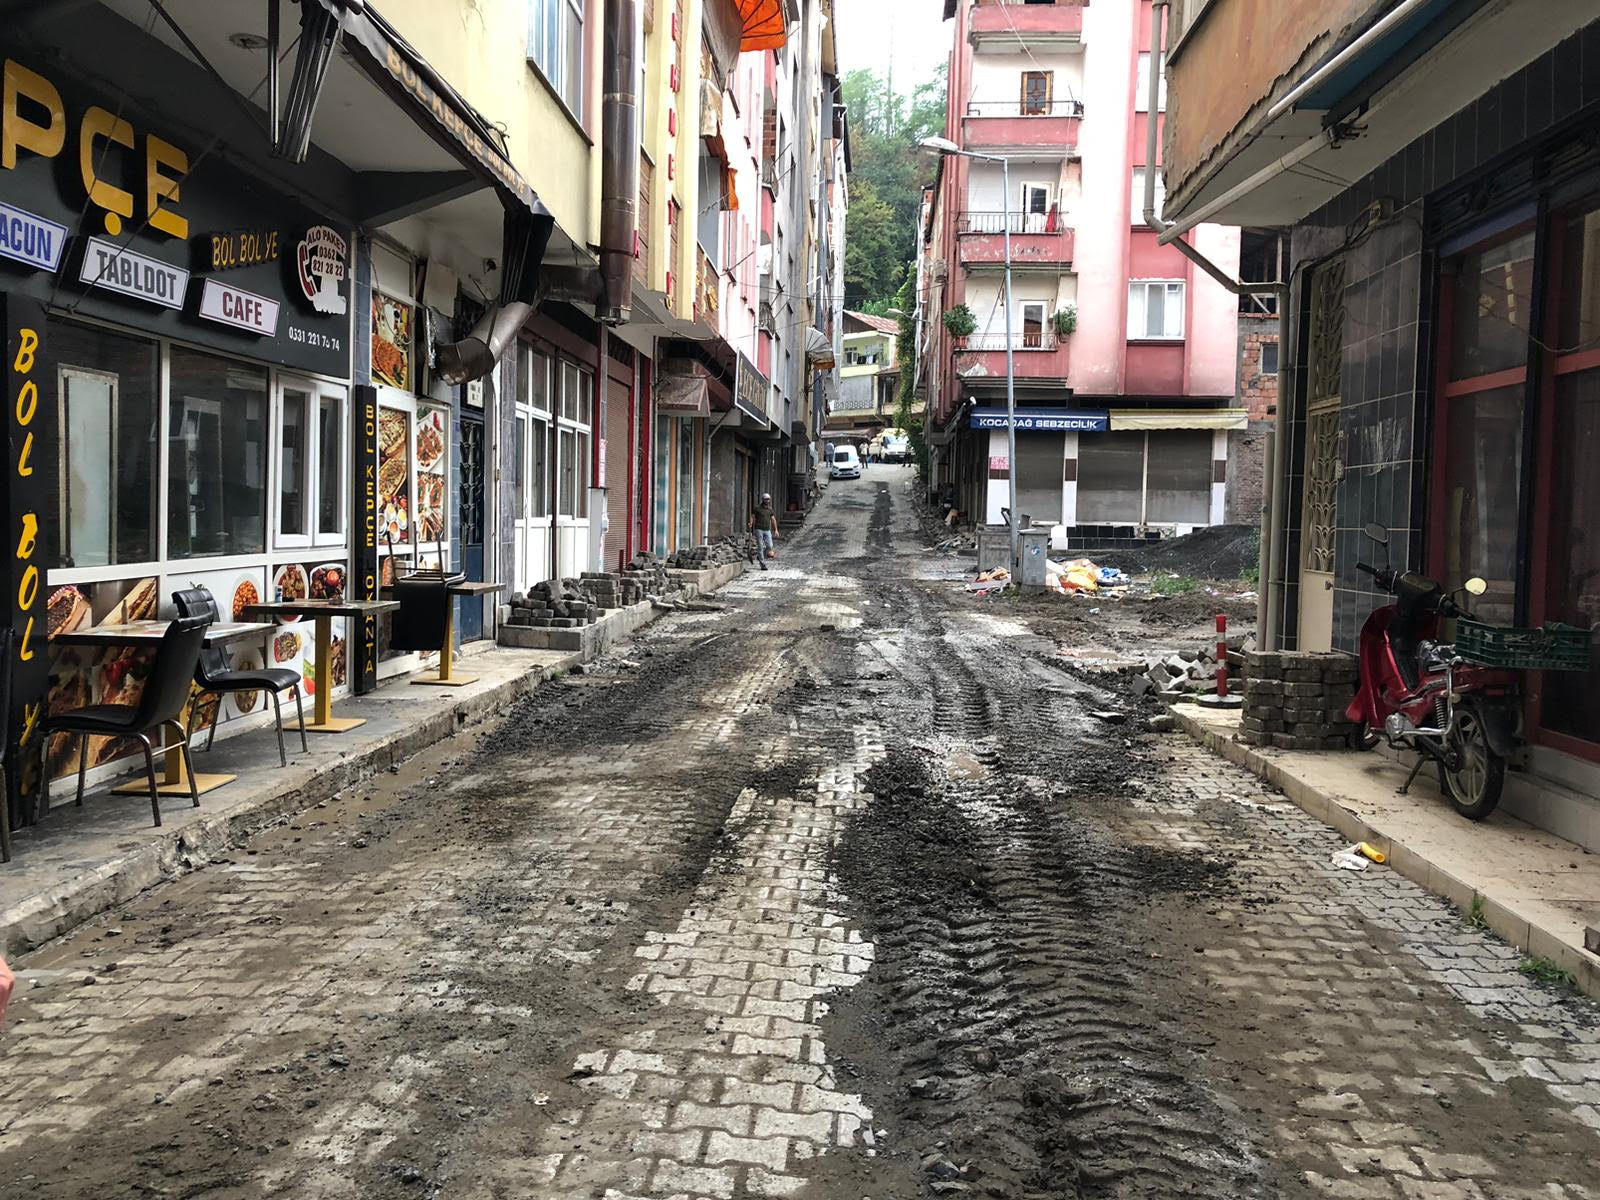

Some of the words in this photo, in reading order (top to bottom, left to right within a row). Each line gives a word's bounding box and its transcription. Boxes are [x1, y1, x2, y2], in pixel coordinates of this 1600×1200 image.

[1, 57, 189, 240] PÇE
[211, 236, 236, 266] BOL
[239, 233, 261, 262] BOL
[264, 231, 279, 259] YE
[307, 229, 321, 246] ALO
[322, 229, 345, 254] PAKET
[319, 245, 336, 261] 0362
[96, 248, 177, 300] TABLDOT
[312, 259, 324, 273] 821
[325, 261, 334, 275] 28
[335, 263, 343, 277] 22
[222, 291, 262, 326] CAFE
[307, 331, 320, 346] 221
[331, 338, 340, 351] 74
[13, 328, 39, 477] BOL
[365, 404, 374, 453] BOL
[1035, 419, 1097, 429] SEBZECİLİK
[16, 512, 39, 661] BOL
